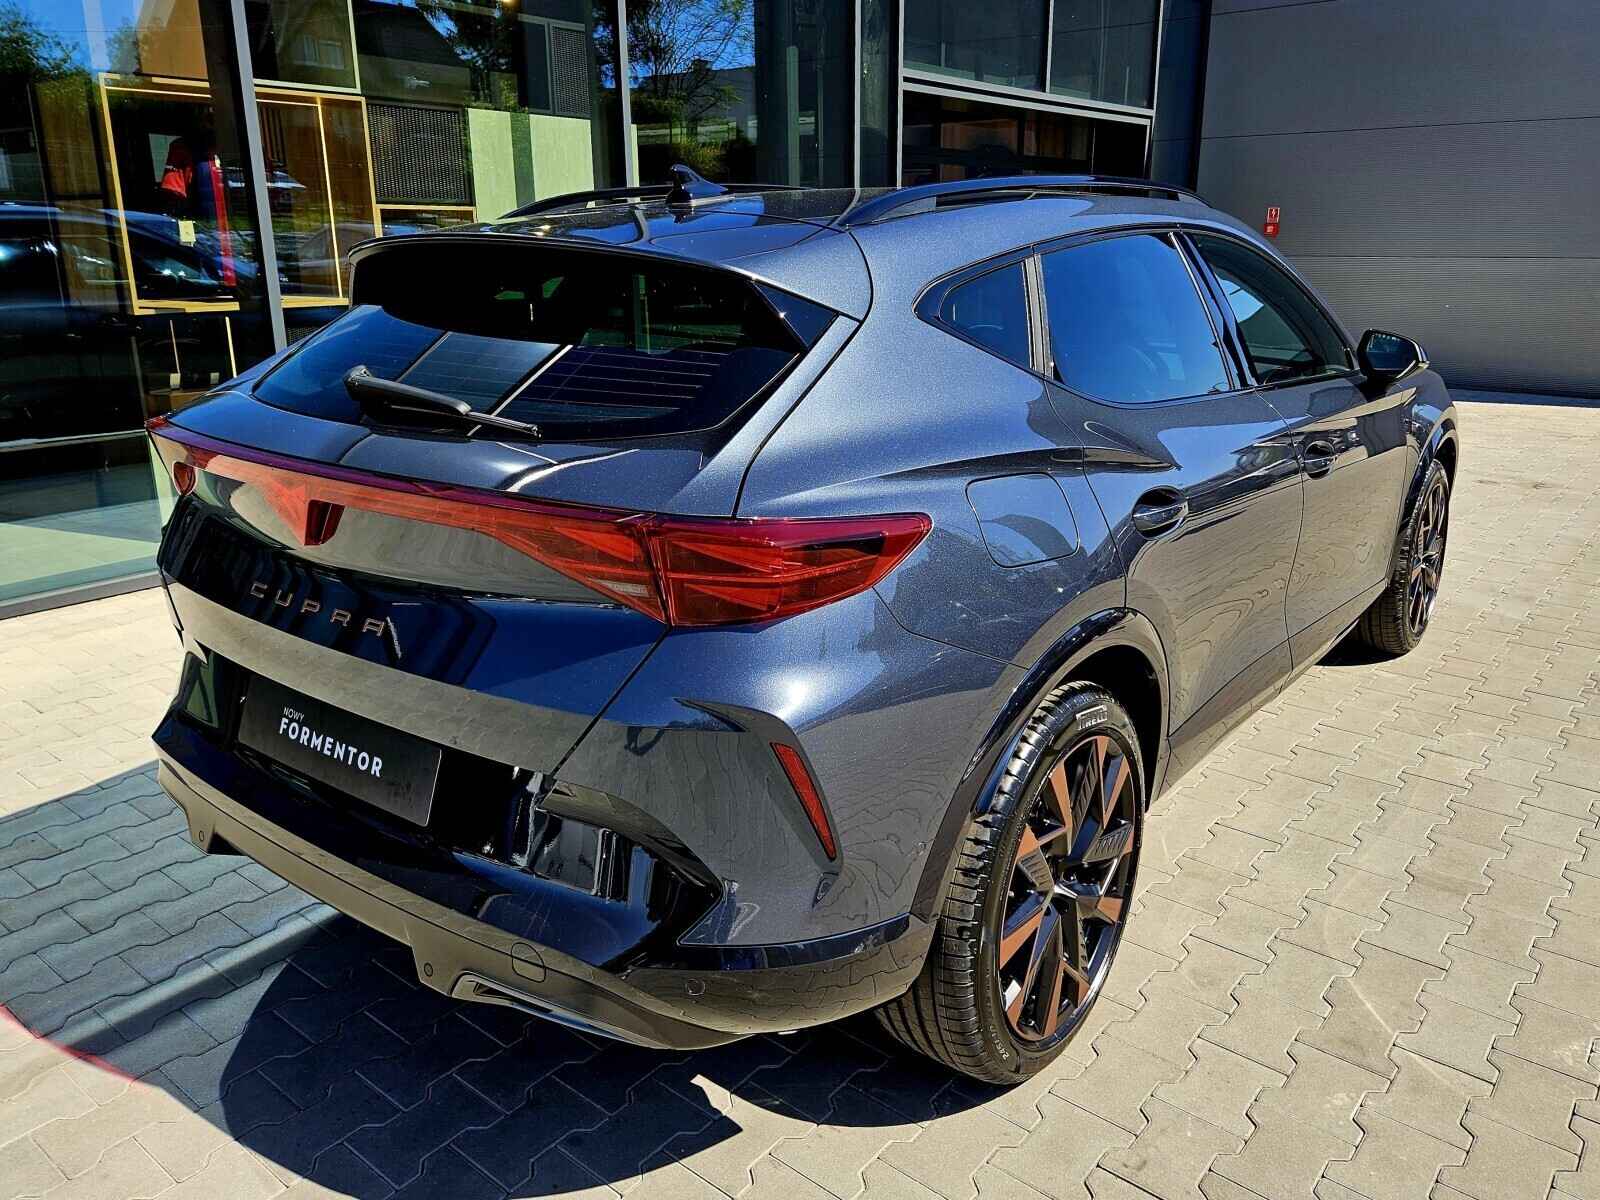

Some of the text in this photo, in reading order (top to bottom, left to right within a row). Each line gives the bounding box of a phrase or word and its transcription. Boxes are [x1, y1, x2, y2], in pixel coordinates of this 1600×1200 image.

[250, 581, 386, 636] CUPRA
[282, 706, 305, 723] NOWY
[279, 718, 383, 777] FORMENTOR
